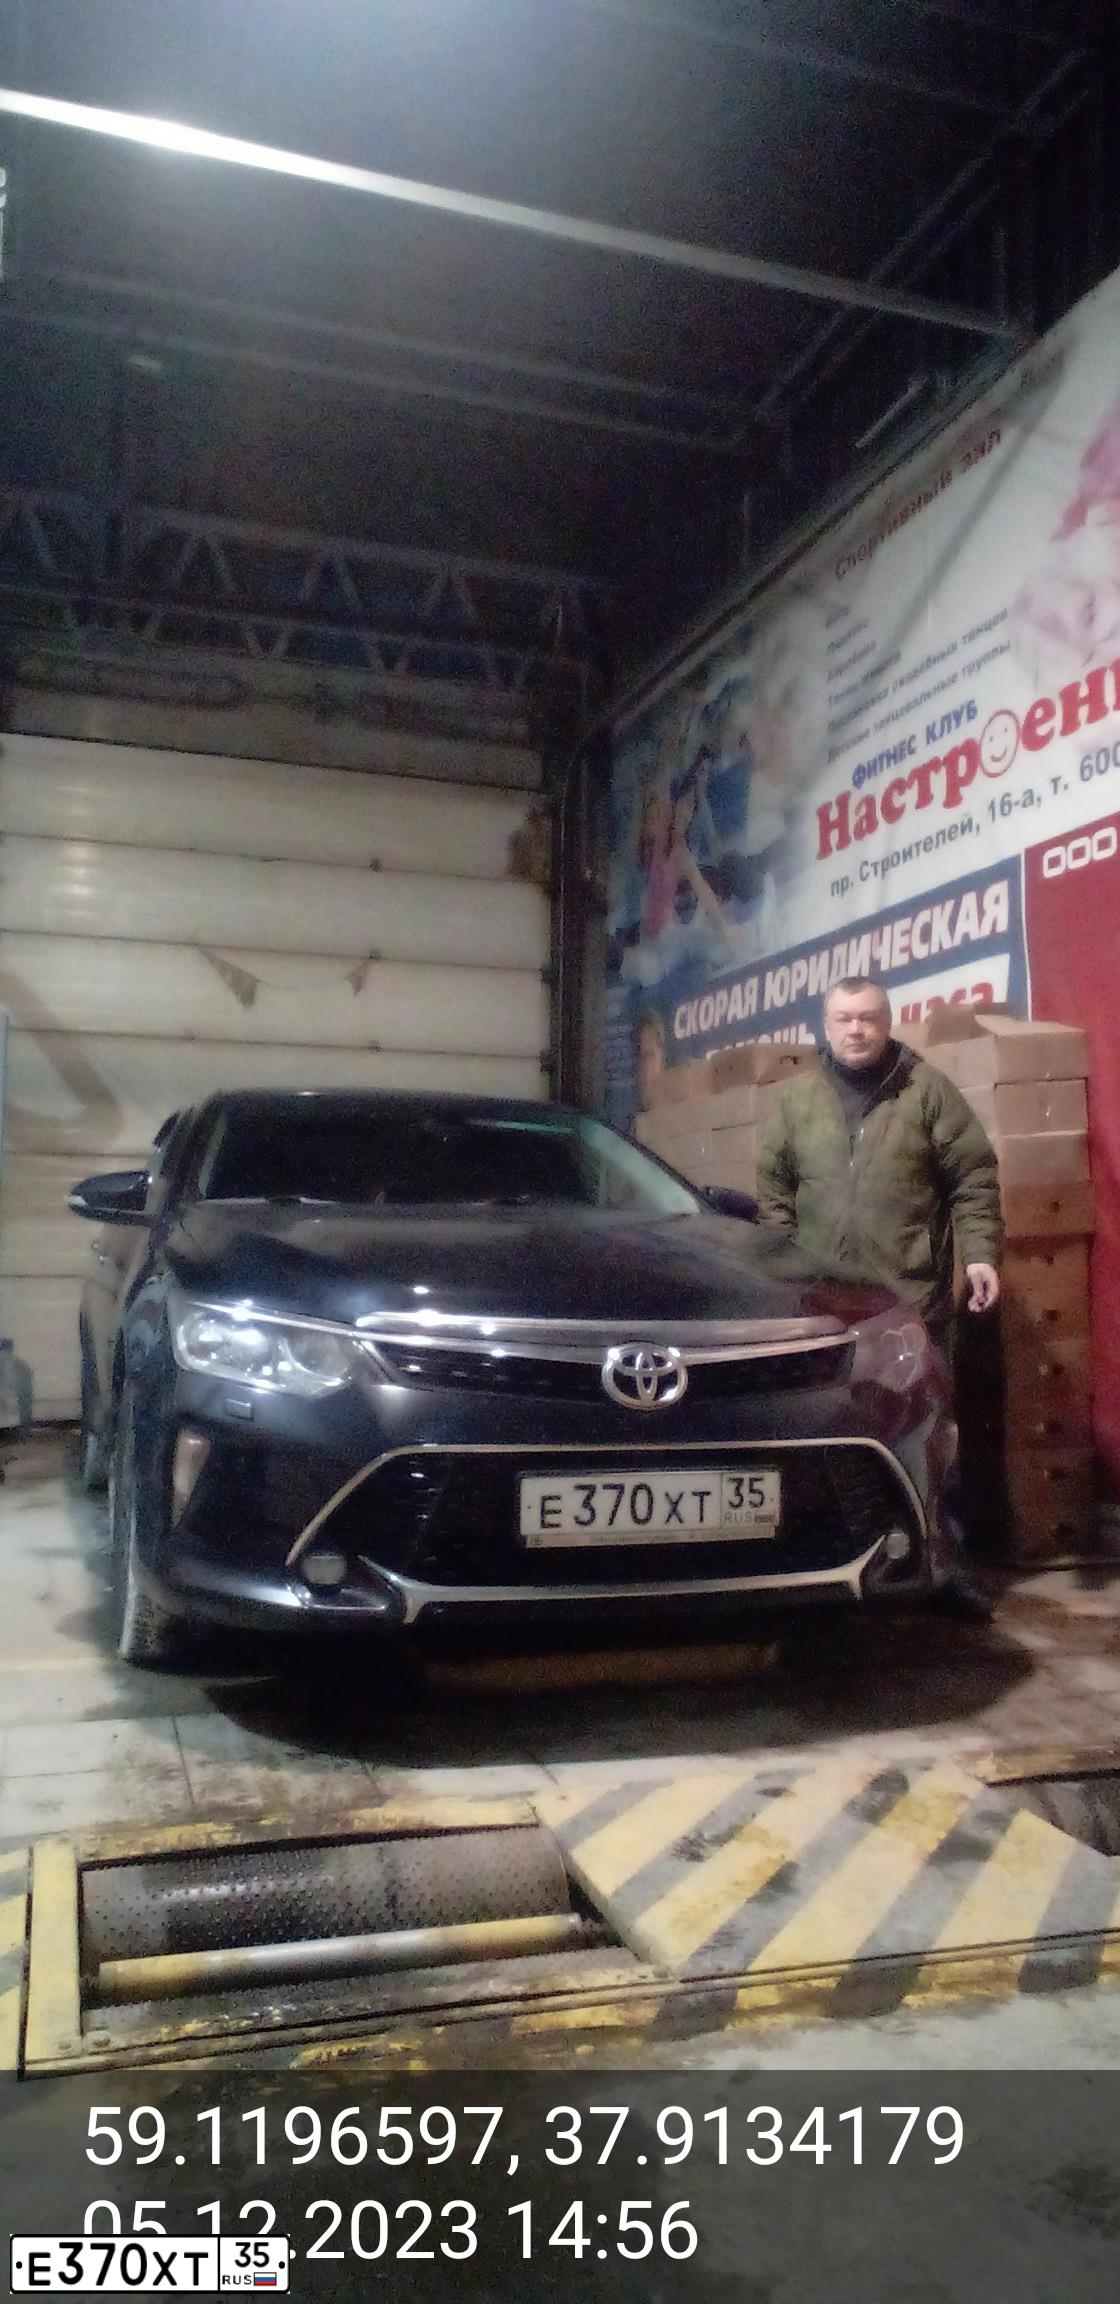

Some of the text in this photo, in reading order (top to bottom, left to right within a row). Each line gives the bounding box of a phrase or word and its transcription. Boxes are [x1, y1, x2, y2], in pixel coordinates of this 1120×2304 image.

[961, 640, 1012, 678] группы
[852, 699, 979, 789] ФИТНЕС КЛУБ
[830, 871, 854, 899] пр.
[858, 810, 981, 884] Строителей,
[987, 787, 1042, 824] 16-а,
[1050, 775, 1069, 796] т.
[673, 879, 1010, 1041] СКОРАЯ ЮРИДИЧЕСКАЯ
[724, 1510, 754, 1525] RUS
[727, 1477, 766, 1509] 35
